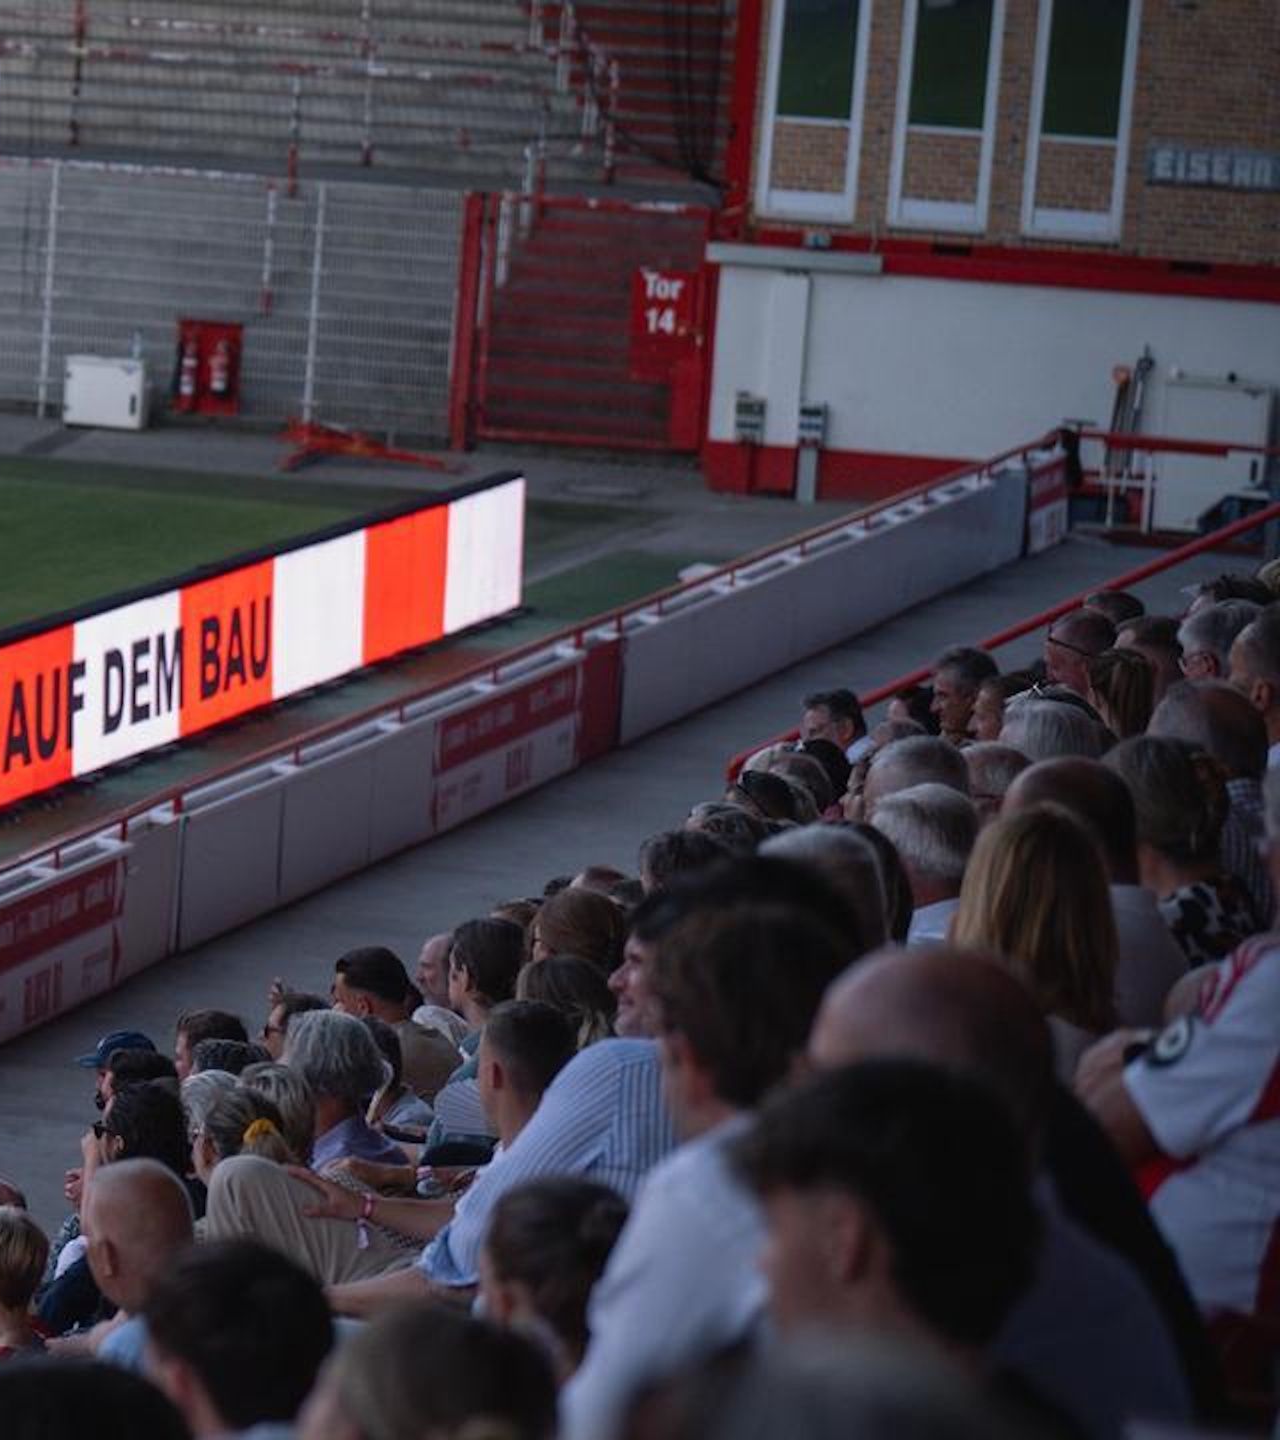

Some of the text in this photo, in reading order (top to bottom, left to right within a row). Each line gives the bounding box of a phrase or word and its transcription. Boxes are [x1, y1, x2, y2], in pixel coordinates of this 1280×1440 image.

[643, 271, 684, 299] Tor
[646, 309, 675, 334] 14
[3, 659, 87, 773] AUF
[103, 627, 184, 736] DEM
[200, 596, 271, 701] BAU
